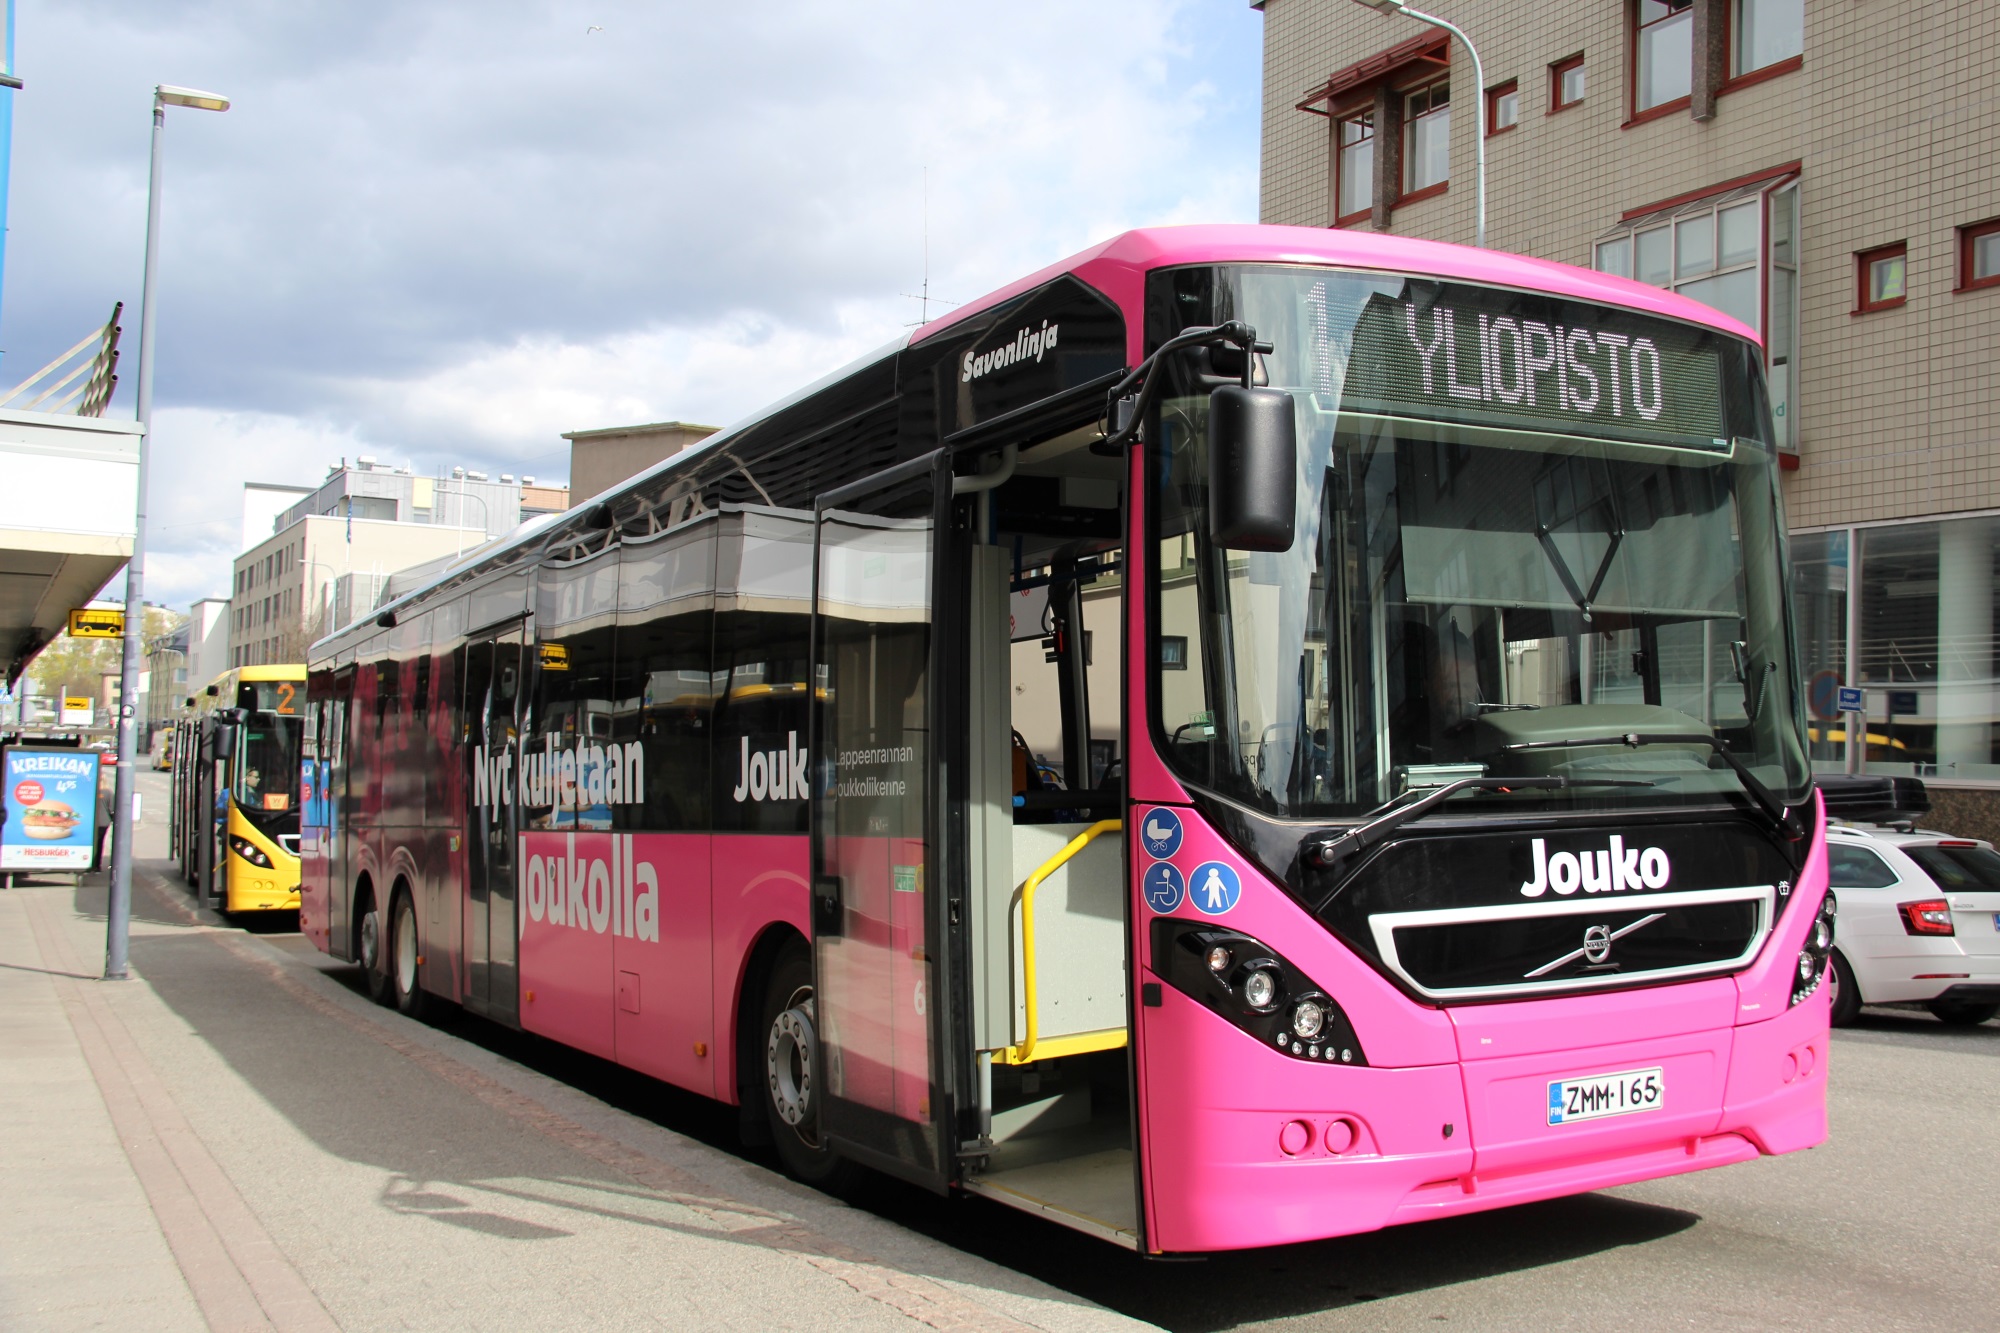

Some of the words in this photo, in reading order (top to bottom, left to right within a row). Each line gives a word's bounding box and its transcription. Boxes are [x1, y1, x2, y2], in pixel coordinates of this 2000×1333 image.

[962, 319, 1059, 383] Savonlinja
[1307, 281, 1330, 396] 1
[1406, 303, 1663, 421] YLIOPISTO
[276, 683, 296, 715] 2
[11, 757, 93, 776] KREIKAN
[474, 744, 512, 823] Nyt
[519, 731, 644, 826] kuljetaan
[733, 730, 827, 803] Jouk
[835, 746, 912, 771] Lappeenrannan
[835, 776, 906, 802] joukkoliikenne
[24, 847, 69, 857] HESBURGER
[1520, 834, 1669, 897] Jouko
[1550, 1106, 1562, 1117] FIN
[1566, 1075, 1658, 1115] ZMM-165
